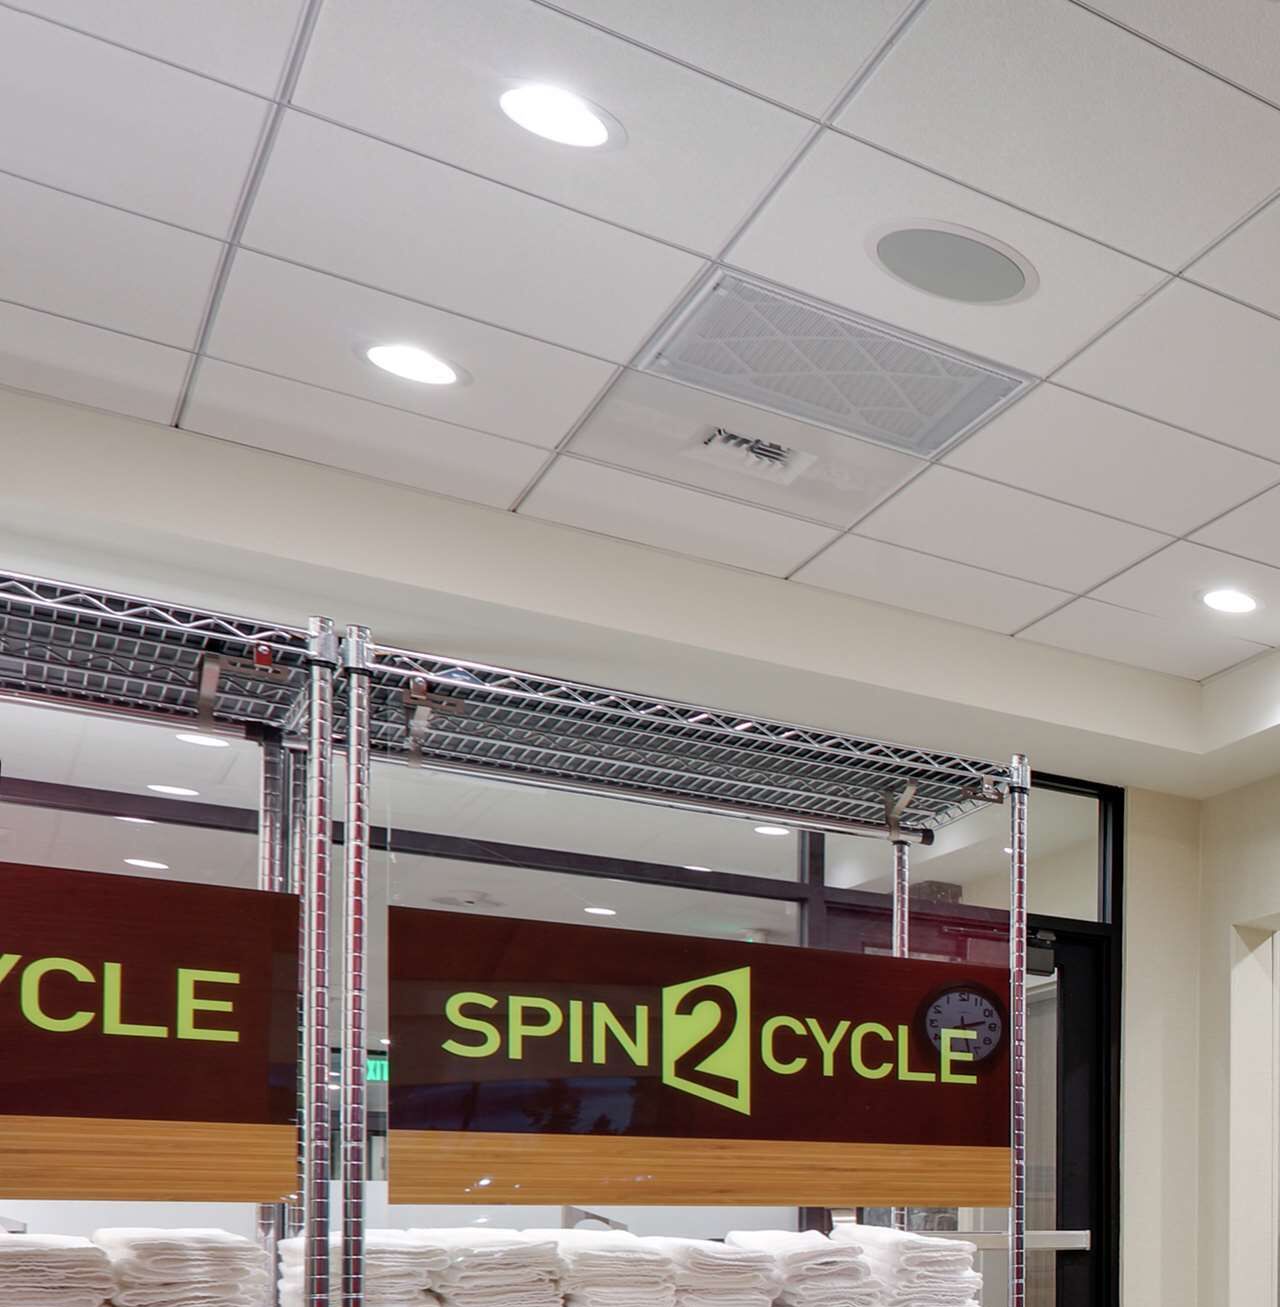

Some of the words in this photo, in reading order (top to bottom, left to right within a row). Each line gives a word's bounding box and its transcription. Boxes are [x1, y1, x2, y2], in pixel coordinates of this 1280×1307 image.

[0, 953, 240, 1043] CLE
[441, 991, 649, 1067] SPIN
[670, 976, 744, 1107] 2
[760, 1015, 978, 1085] CYCLE
